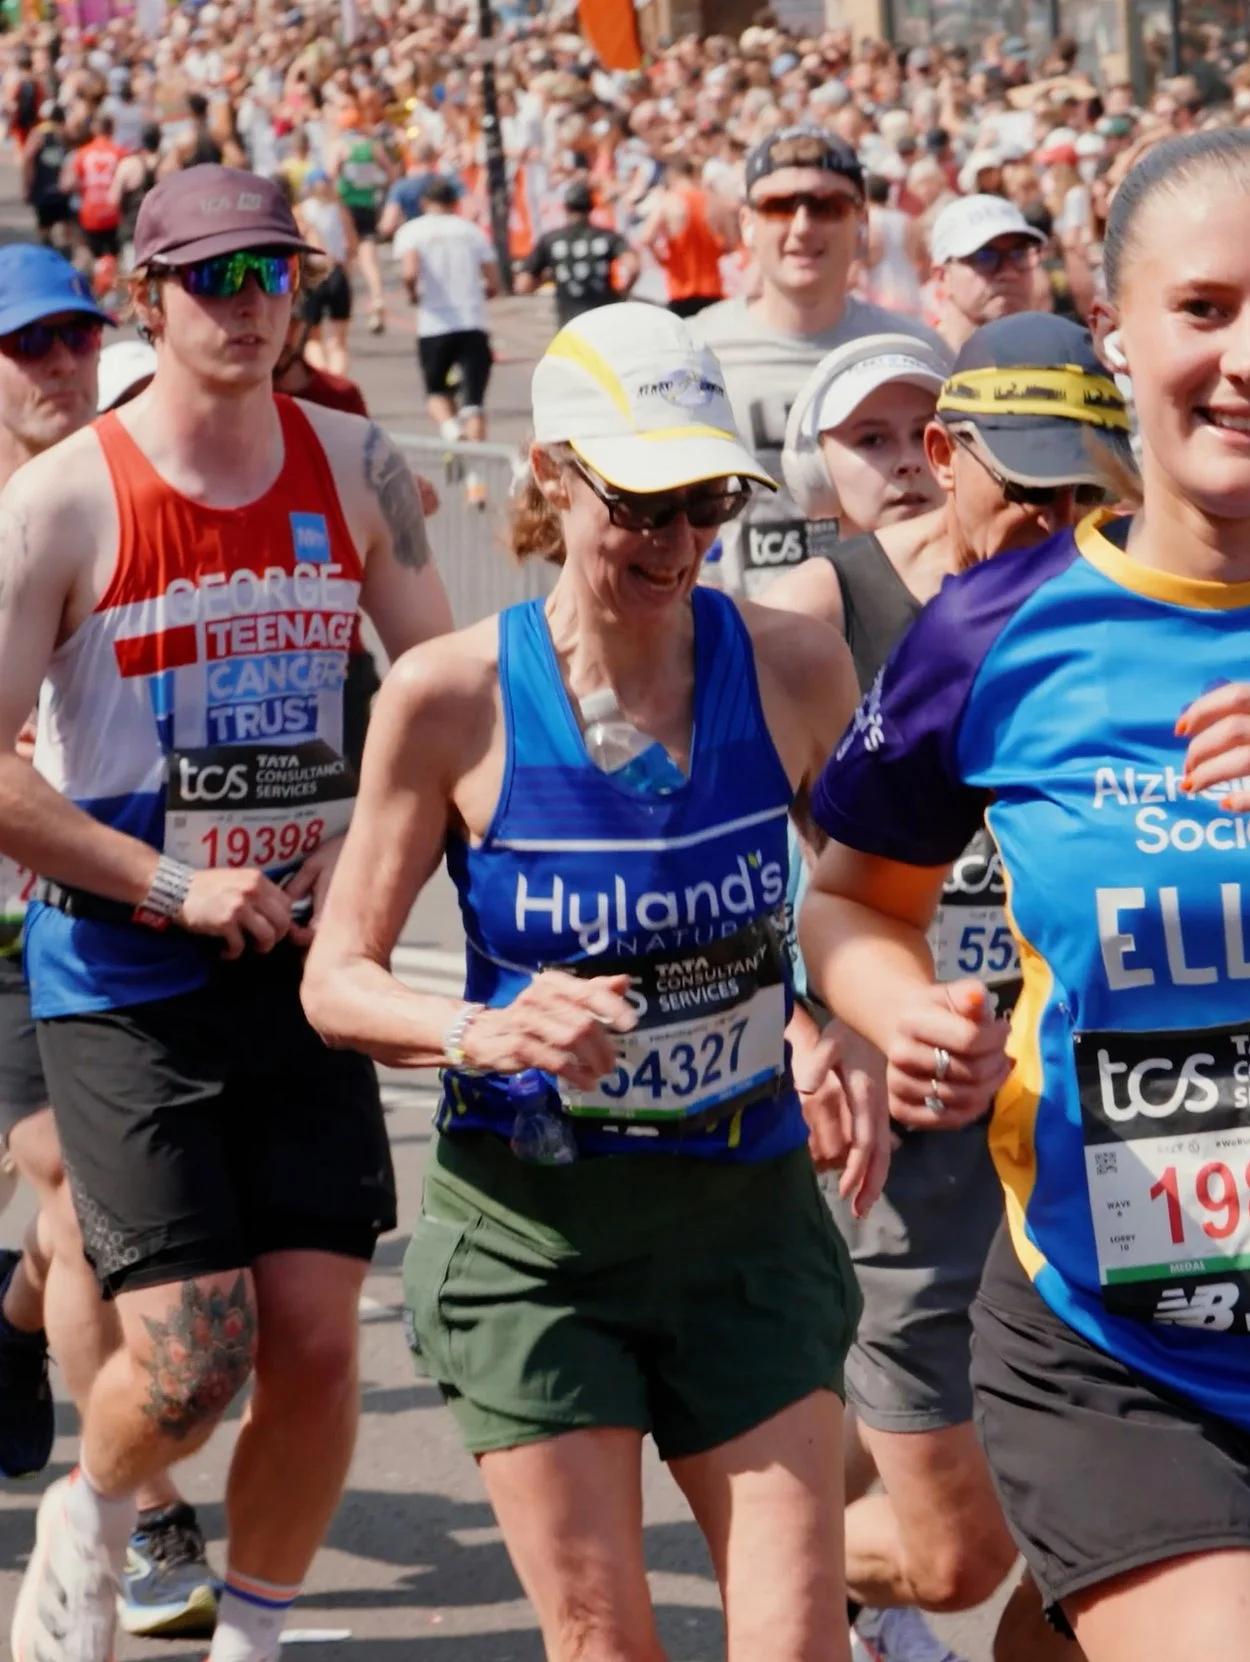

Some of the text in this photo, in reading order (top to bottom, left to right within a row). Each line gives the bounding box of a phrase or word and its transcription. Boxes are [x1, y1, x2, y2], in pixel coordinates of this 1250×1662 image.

[749, 526, 803, 565] tcs
[165, 563, 343, 624] GEORGE
[178, 756, 249, 801] tcs
[256, 754, 299, 769] TATA
[256, 760, 346, 784] CONSULTANCY
[256, 781, 318, 799] SERVICES
[201, 817, 326, 870] 19398
[515, 849, 784, 955] Hyland's
[655, 956, 709, 978] TATA
[658, 978, 740, 1013] SERVICES
[600, 1017, 749, 1100] 54327
[1097, 1048, 1220, 1122] tcs
